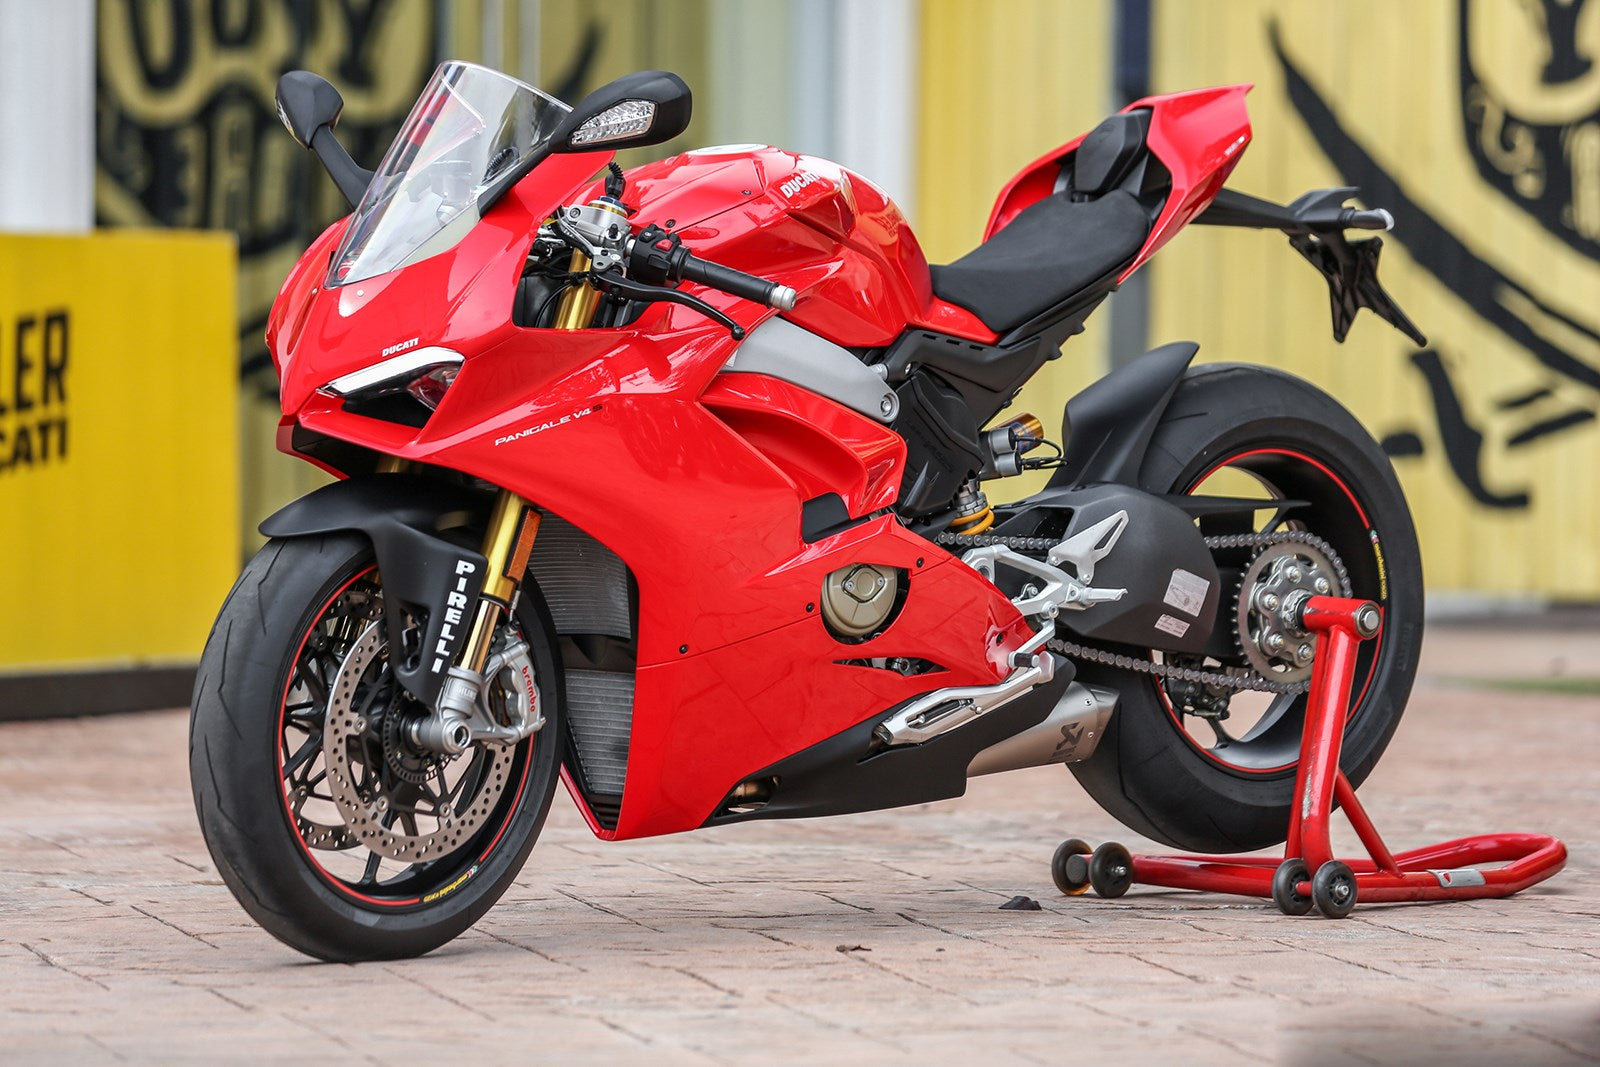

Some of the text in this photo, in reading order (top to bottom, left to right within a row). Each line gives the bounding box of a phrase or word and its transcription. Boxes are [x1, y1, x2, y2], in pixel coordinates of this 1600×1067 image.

[382, 337, 419, 357] DUCATI
[495, 415, 571, 446] PANIGALE
[431, 560, 475, 673] PIRELLI
[522, 665, 537, 712] brembo
